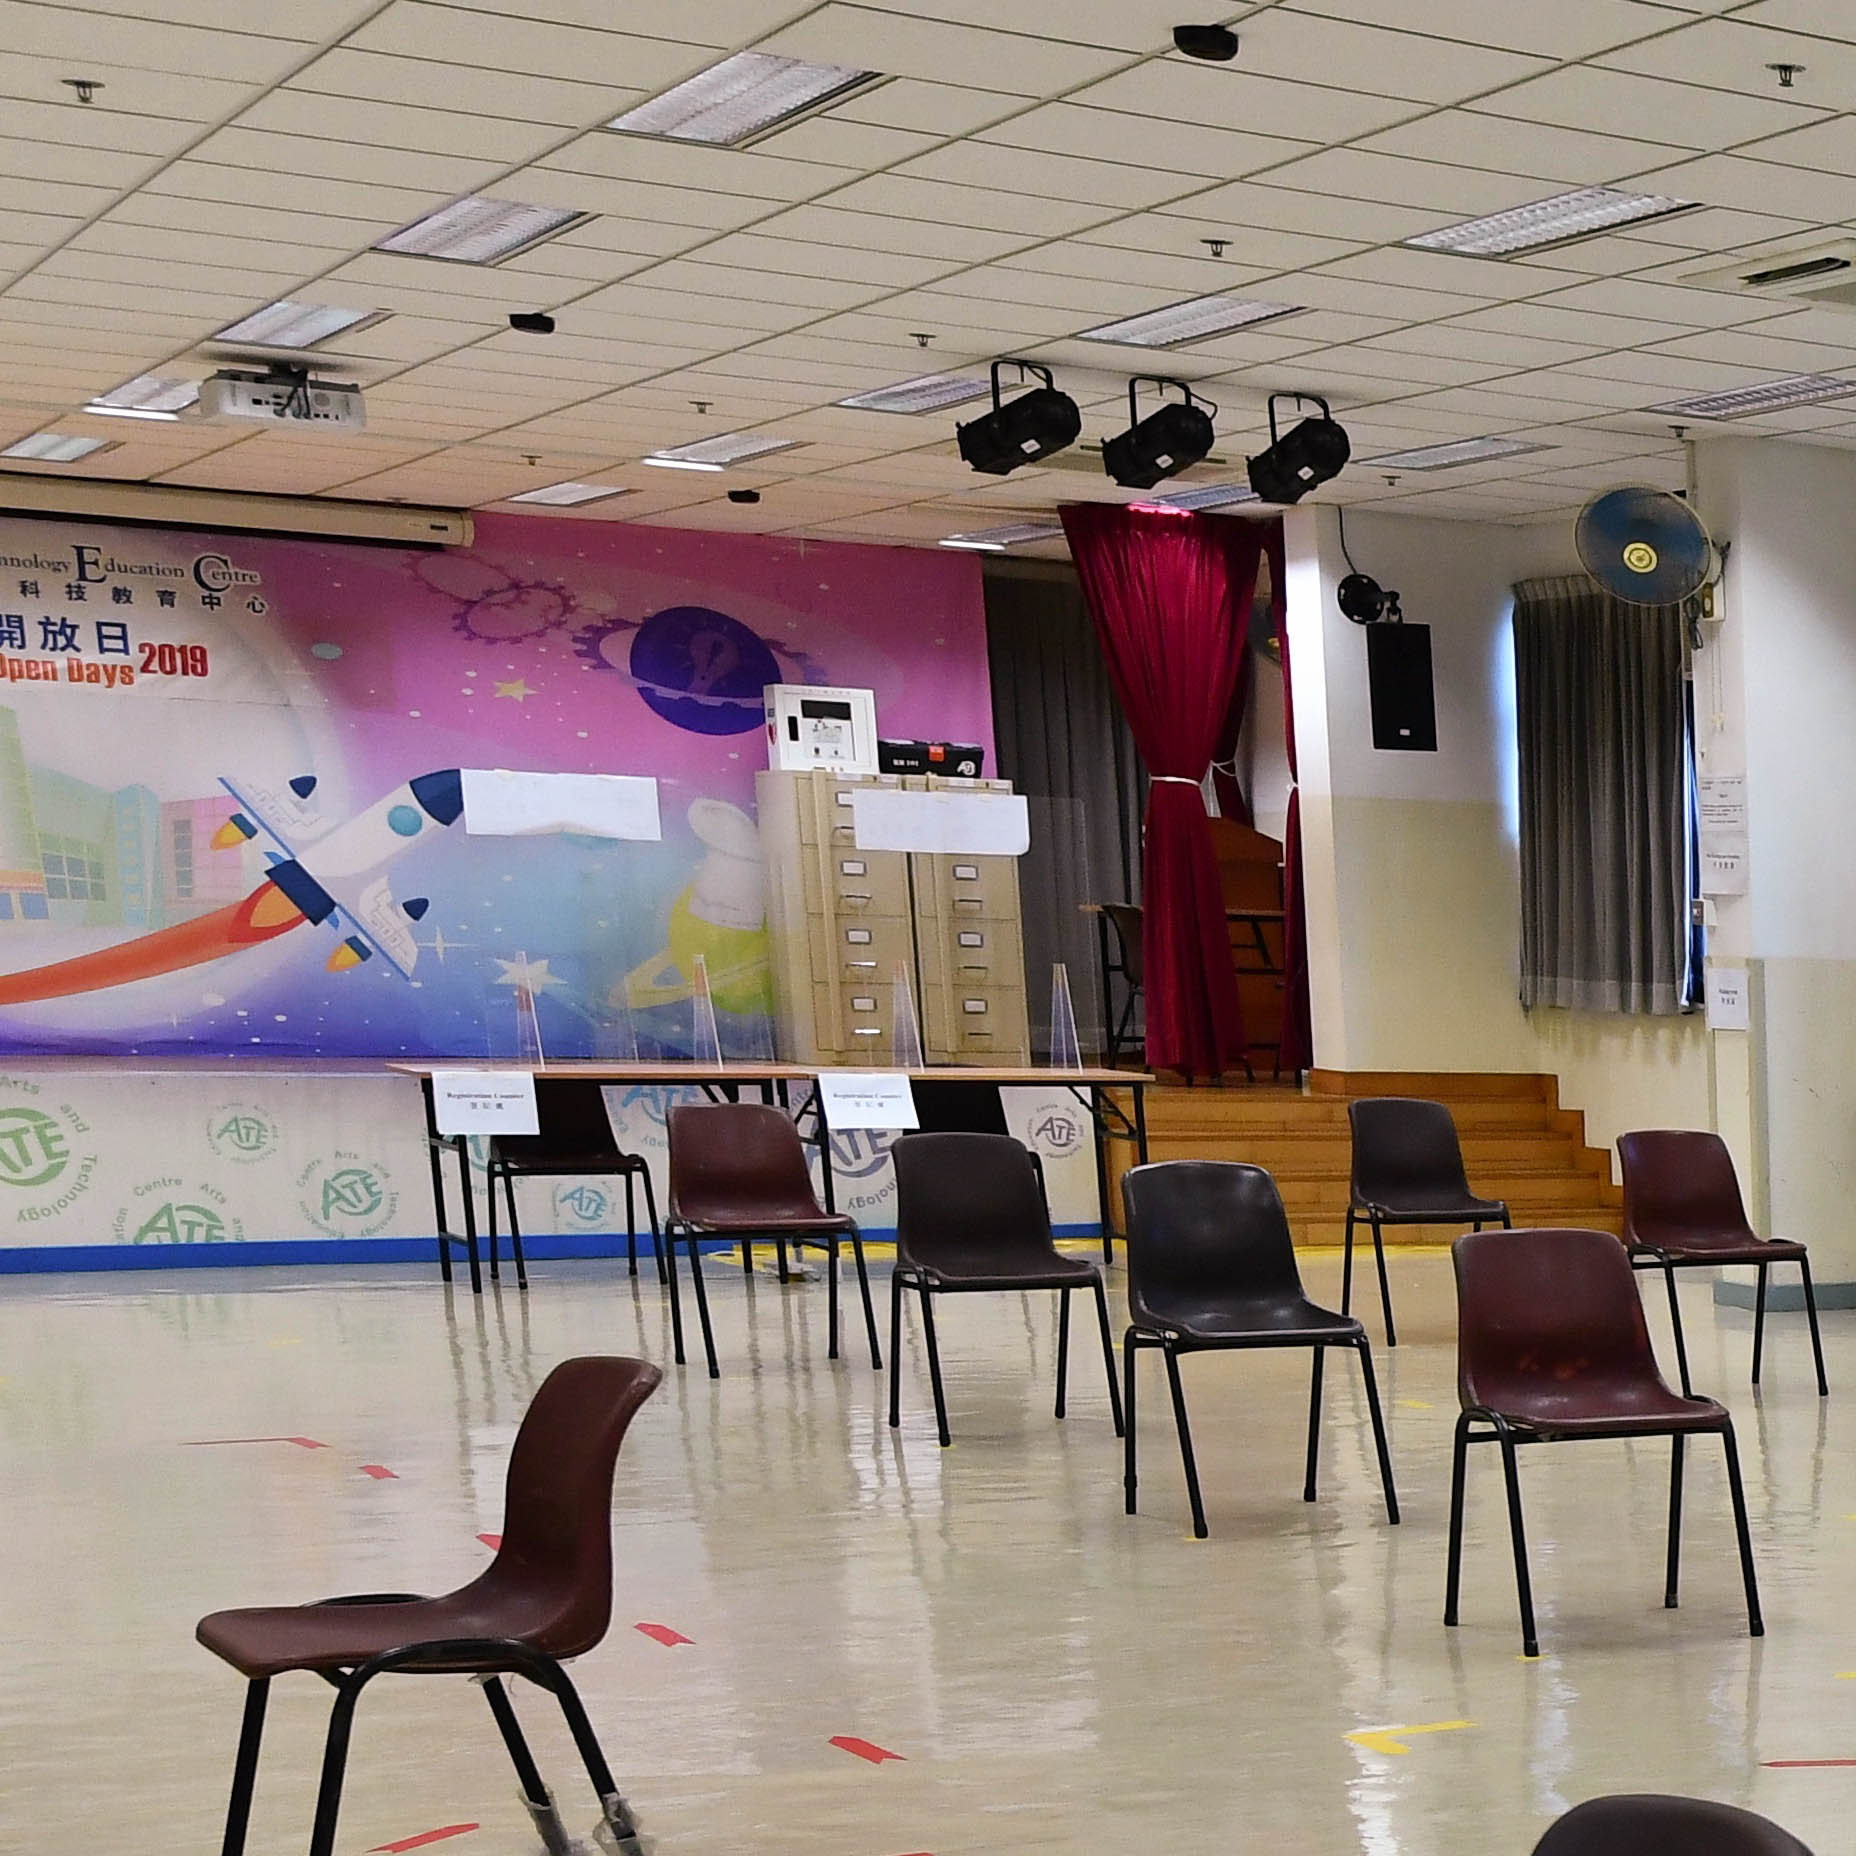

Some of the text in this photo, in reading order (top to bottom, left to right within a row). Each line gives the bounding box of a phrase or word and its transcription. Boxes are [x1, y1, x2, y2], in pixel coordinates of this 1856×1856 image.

[70, 544, 184, 583] Education
[193, 554, 259, 592] Centre
[0, 613, 131, 656] 開放日
[67, 656, 135, 688] Days
[138, 642, 209, 677] 2019
[60, 1104, 90, 1133] and
[216, 1116, 269, 1145] ATE
[1035, 1116, 1077, 1142] ATE
[17, 1153, 98, 1224] Technology
[133, 1177, 183, 1197] Centre
[200, 1182, 227, 1204] Arts
[321, 1169, 383, 1221] ATE
